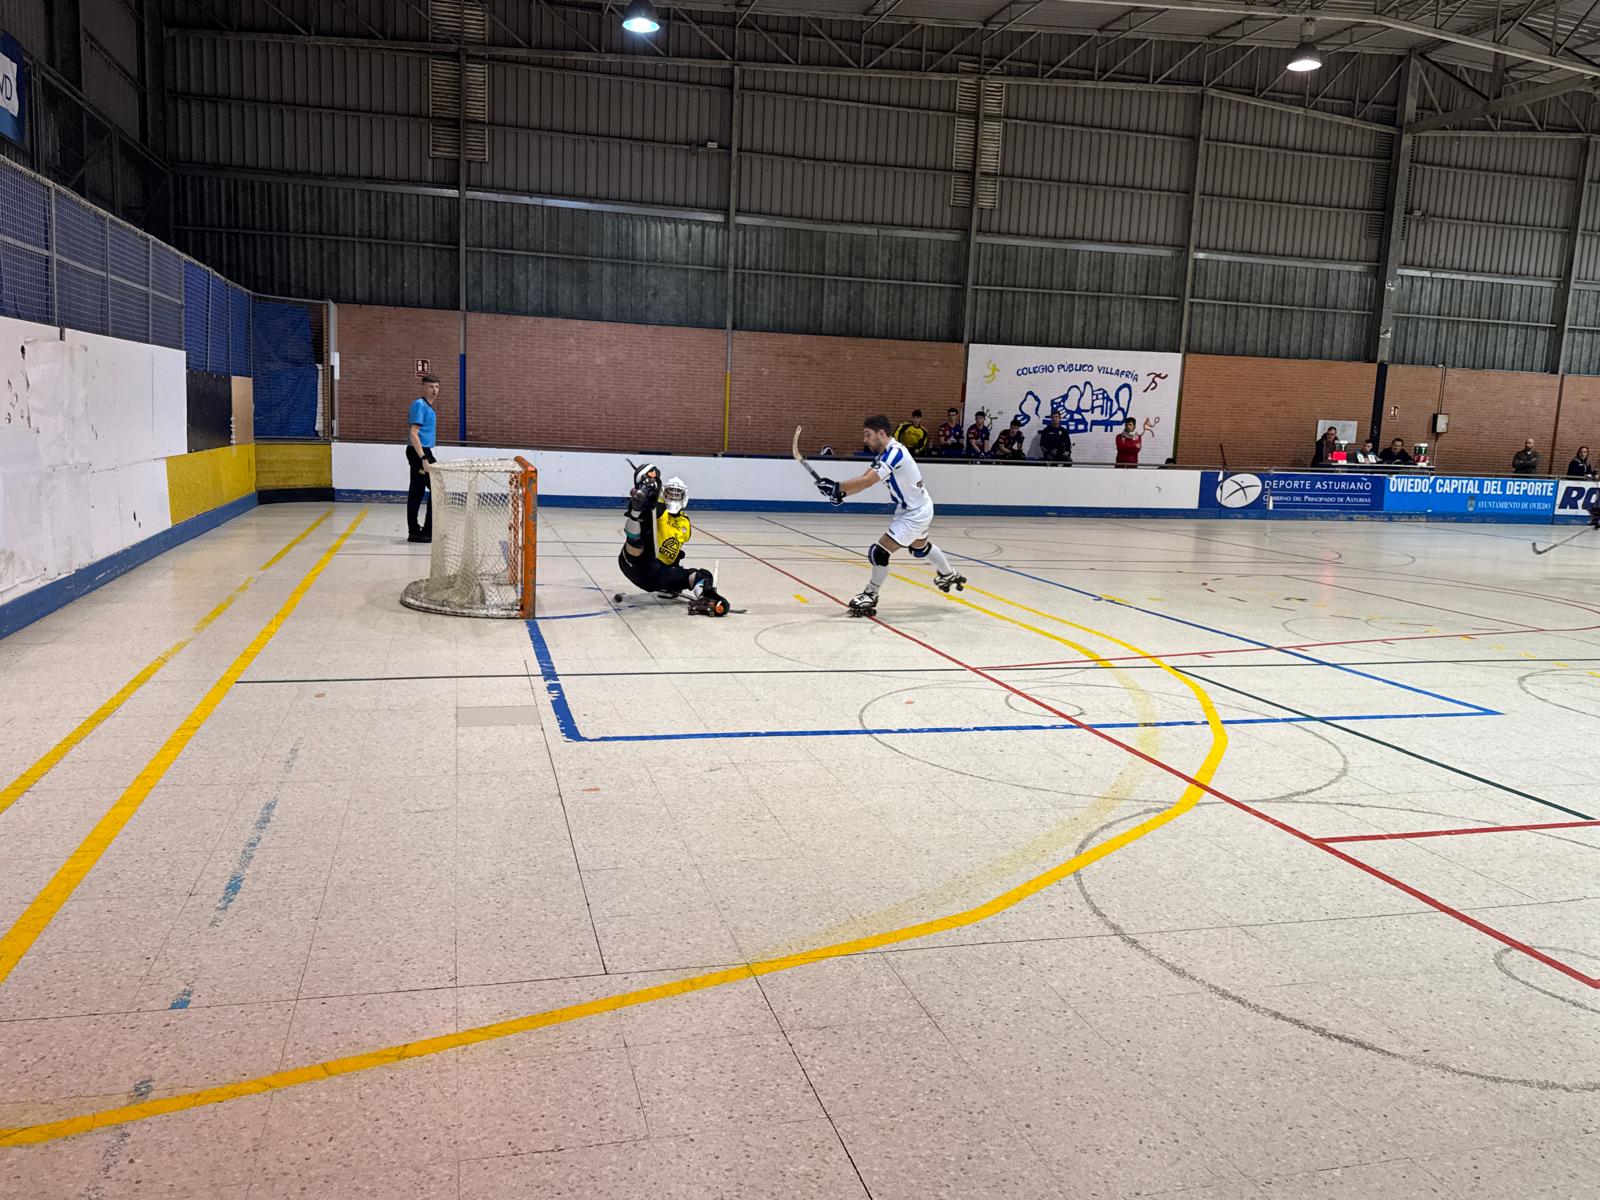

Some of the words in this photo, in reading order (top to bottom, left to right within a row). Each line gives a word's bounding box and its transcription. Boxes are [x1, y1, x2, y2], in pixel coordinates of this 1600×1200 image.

[1016, 364, 1055, 377] COLEGIO
[1057, 361, 1094, 373] PÚBLICO
[1097, 365, 1139, 382] VILLAFRÍA
[1264, 480, 1311, 490] DEPORTE
[1314, 480, 1372, 491] ASTURIANO
[1389, 477, 1432, 495] OVIEDO,
[1435, 479, 1480, 494] CAPITAL
[1483, 480, 1503, 495] DEL
[1505, 481, 1555, 496] DEPORTE
[1303, 495, 1336, 503] PRINCIPADO
[1345, 496, 1372, 504] ASTURIAS
[1478, 500, 1521, 510] AYUNTAMIENTO
[1521, 501, 1529, 509] DE
[1529, 502, 1551, 510] OVIEDO
